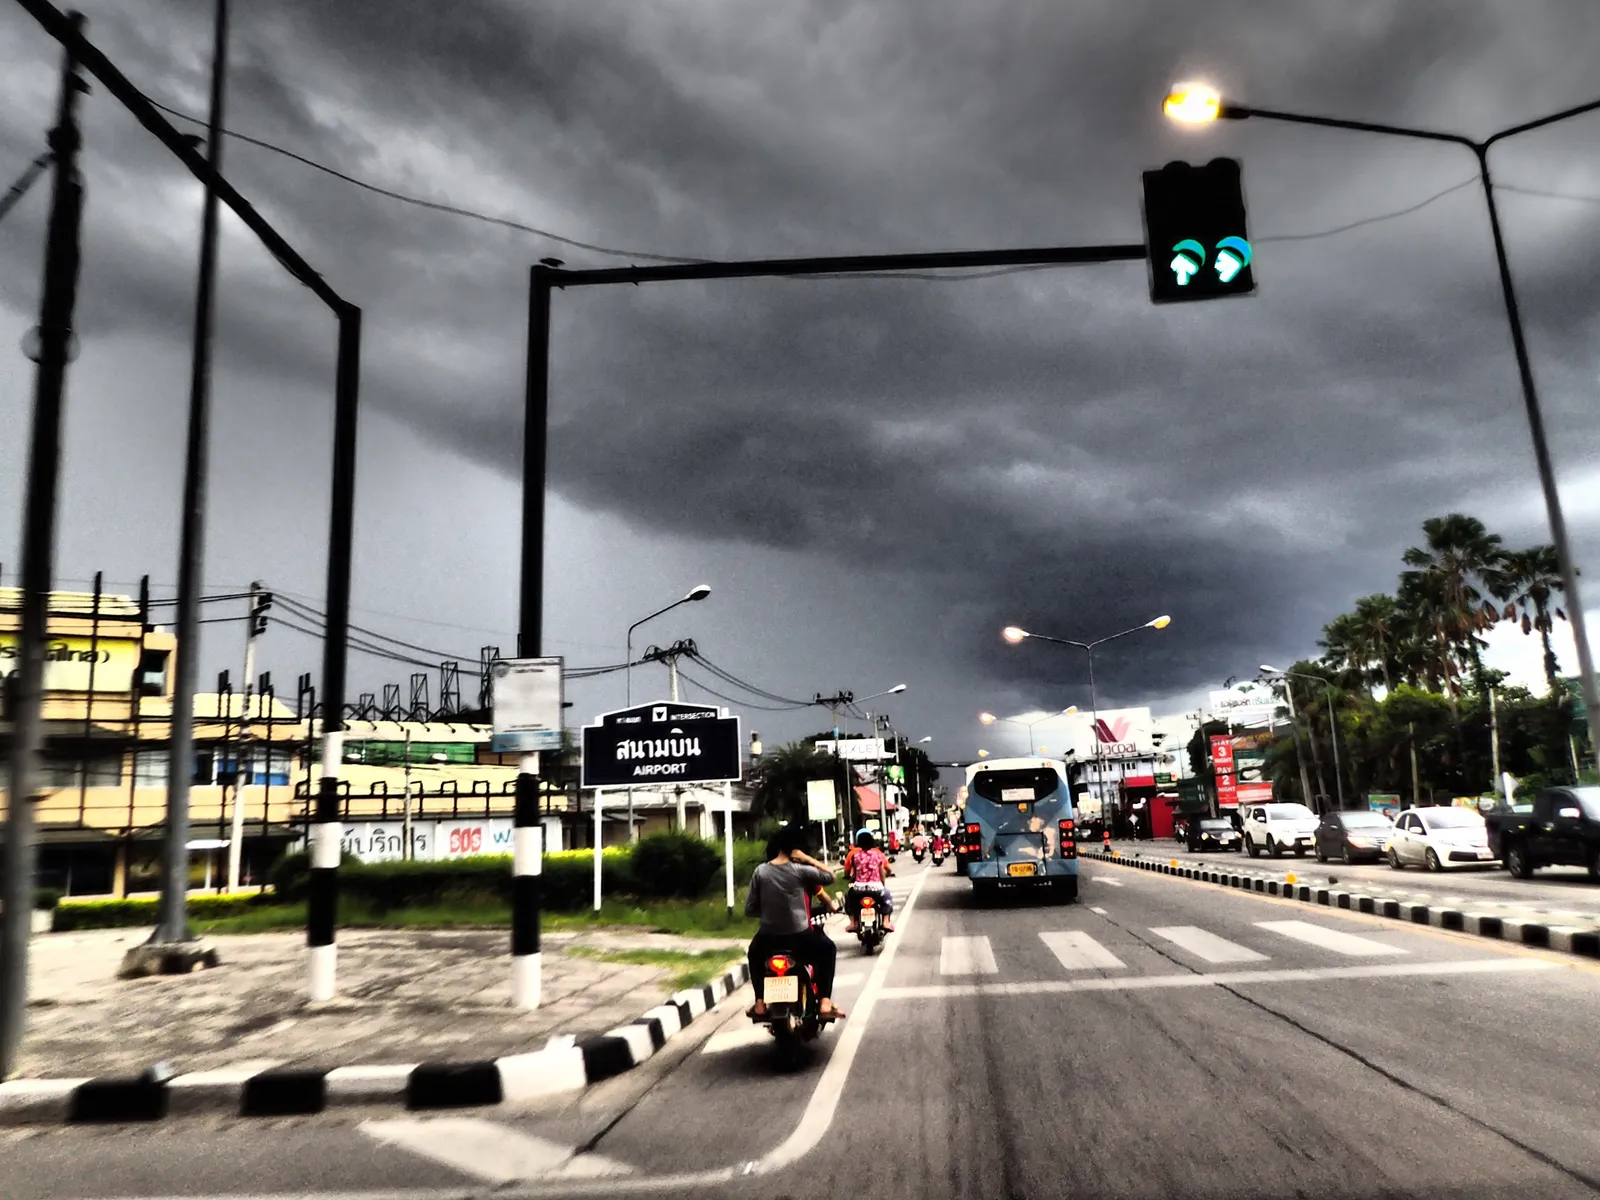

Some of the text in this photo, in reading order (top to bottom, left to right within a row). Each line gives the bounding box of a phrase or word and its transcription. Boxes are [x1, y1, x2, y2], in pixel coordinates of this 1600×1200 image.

[670, 711, 716, 721] INTERSECTION
[616, 727, 701, 760] สนามบิน
[1212, 739, 1230, 747] STAY
[1218, 746, 1226, 757] 3
[633, 762, 687, 776] AIRPORT
[1221, 774, 1230, 785] 2
